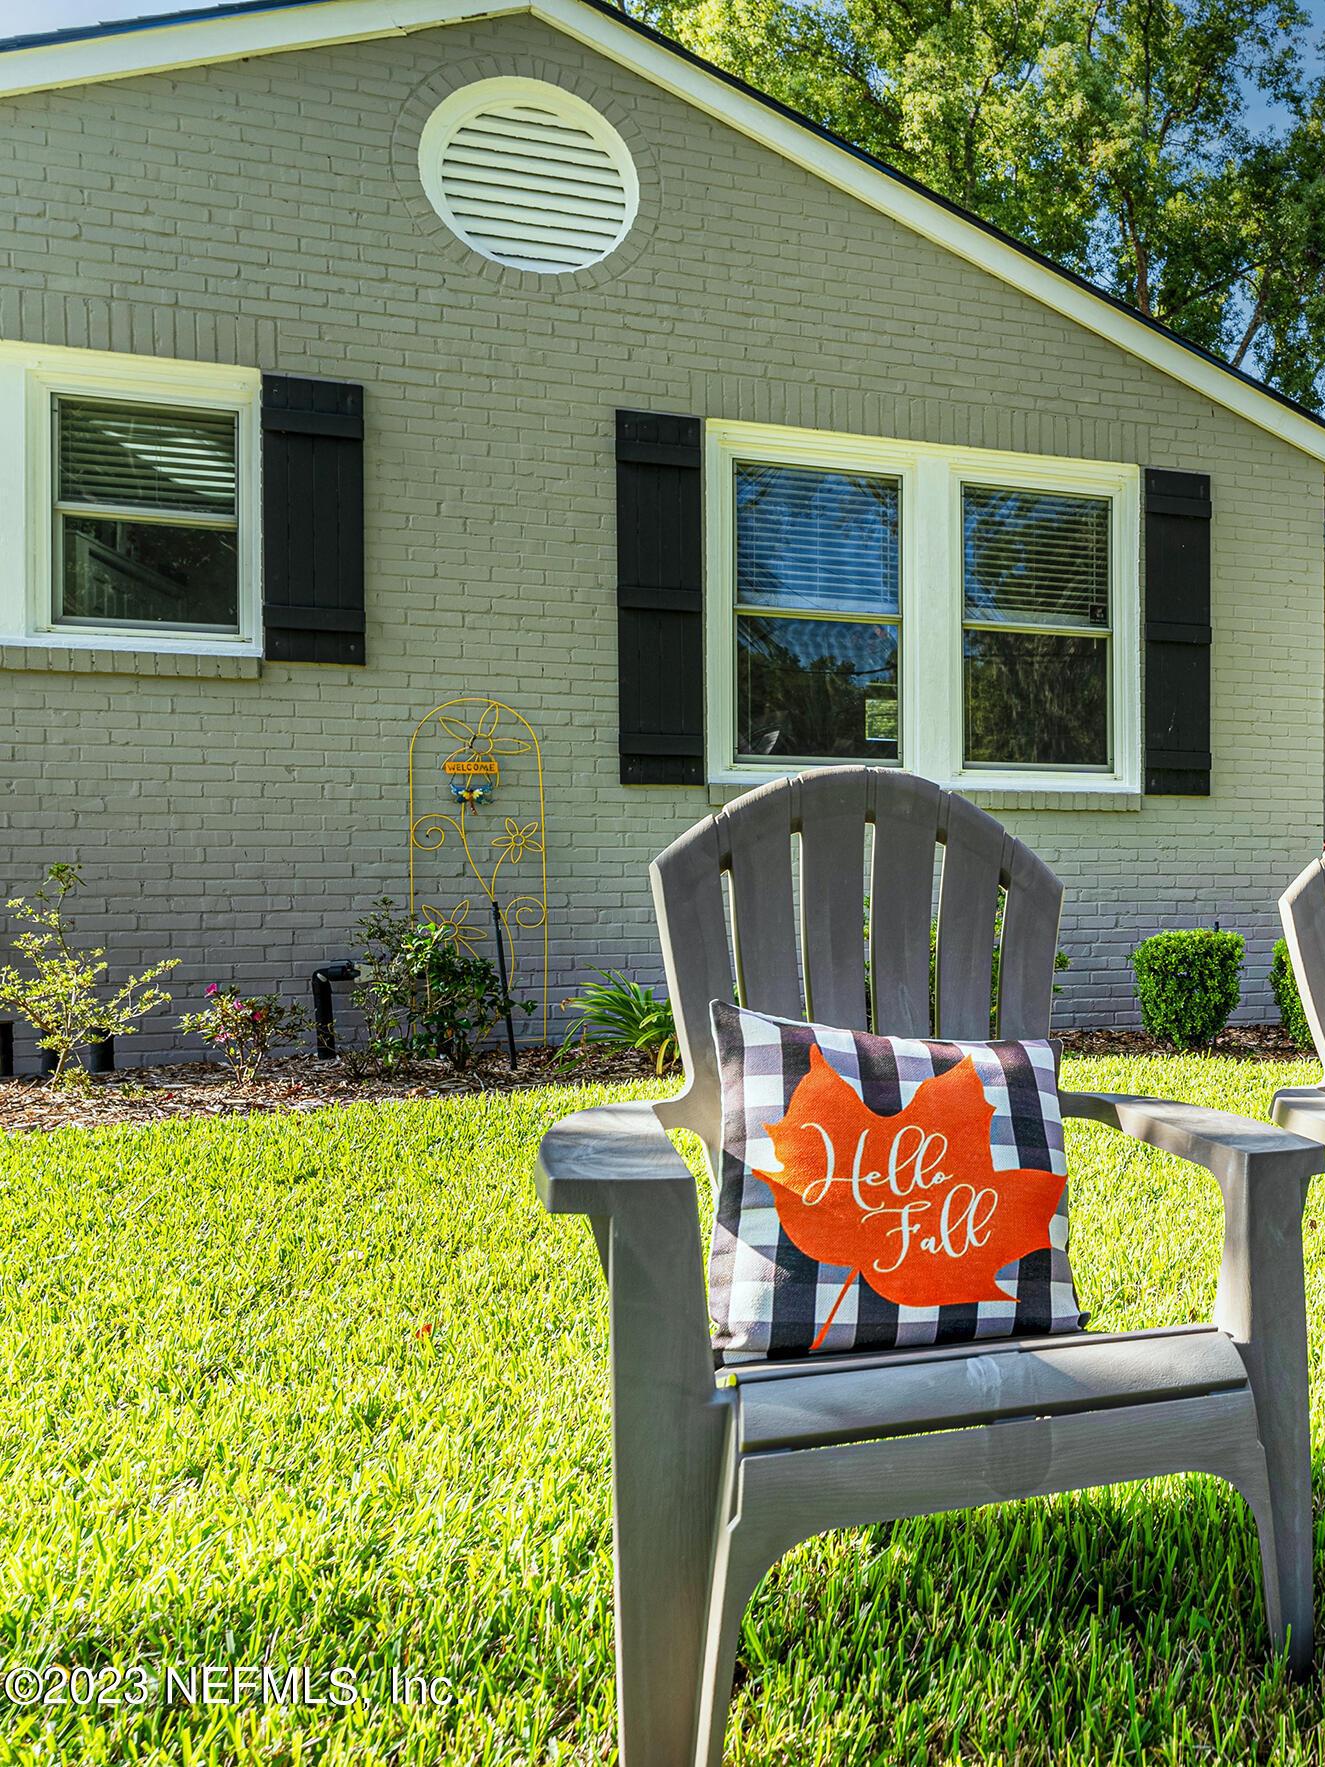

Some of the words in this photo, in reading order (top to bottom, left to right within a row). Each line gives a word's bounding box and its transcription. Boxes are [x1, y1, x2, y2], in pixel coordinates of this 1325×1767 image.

[447, 763, 496, 772] WELCOME
[801, 1122, 953, 1211] Hello
[861, 1183, 999, 1273] Fall
